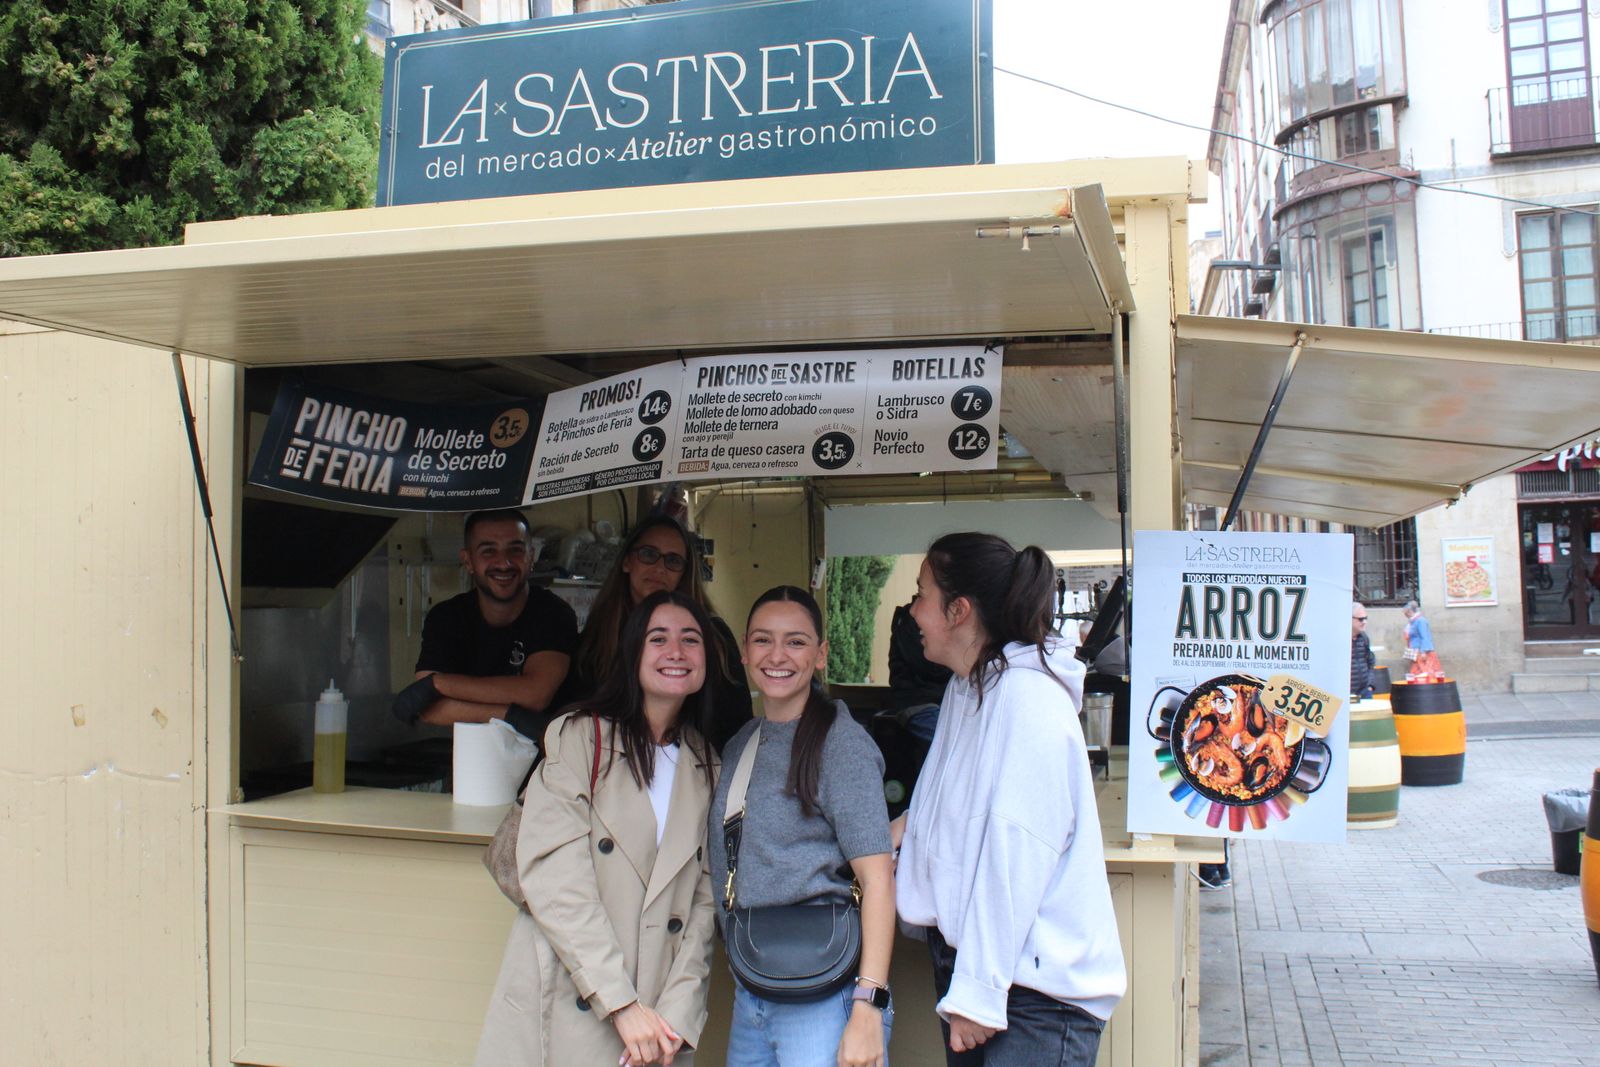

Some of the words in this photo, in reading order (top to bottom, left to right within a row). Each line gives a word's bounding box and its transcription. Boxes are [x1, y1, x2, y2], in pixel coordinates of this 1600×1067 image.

[418, 79, 490, 149] LA
[512, 32, 944, 138] SASTRERIA
[425, 156, 465, 181] del
[477, 142, 601, 175] mercado
[616, 134, 713, 163] Atelier
[718, 114, 937, 157] gastronómico
[697, 364, 769, 388] PINCHOS
[771, 369, 787, 380] DEL
[790, 361, 857, 384] SASTRE
[892, 357, 986, 382] BOTELLAS
[579, 377, 643, 412] PROMOS!
[688, 391, 726, 406] Mollete
[728, 391, 741, 403] de
[743, 390, 783, 402] secreto
[798, 393, 822, 401] kimchi
[877, 394, 945, 408] Lambrusco
[962, 392, 982, 412] 7€
[641, 396, 668, 417] 14€
[686, 406, 724, 420] Mollete
[726, 406, 739, 418] de
[741, 404, 768, 417] lomo
[770, 403, 817, 416] adobado
[833, 407, 855, 416] queso
[876, 411, 883, 420] o
[886, 407, 918, 420] Sidra
[294, 397, 407, 452] PINCHO
[545, 435, 551, 444] +
[553, 433, 560, 443] 4
[560, 426, 595, 442] Pinchos
[597, 424, 609, 435] de
[609, 417, 633, 432] Feria
[547, 417, 578, 434] Botella
[578, 418, 585, 426] de
[585, 415, 600, 425] sidra
[604, 407, 635, 419] Lambrusco
[684, 420, 722, 434] Mollete
[724, 420, 737, 432] de
[739, 419, 778, 432] ternera
[414, 428, 485, 451] Mollete
[639, 433, 659, 454] 8€
[682, 435, 695, 443] con
[695, 434, 706, 443] ajo
[706, 435, 711, 443] y
[712, 432, 734, 442] perejil
[874, 429, 909, 442] Novio
[955, 430, 987, 450] 12€
[283, 446, 307, 469] DE
[539, 452, 569, 469] Ración
[571, 450, 582, 462] de
[584, 442, 620, 460] Secreto
[681, 446, 708, 460] Tarta
[711, 444, 725, 457] de
[728, 444, 763, 460] queso
[765, 444, 805, 456] casera
[819, 439, 847, 462] 3,5€
[873, 441, 925, 455] Perfecto
[303, 443, 395, 495] FERIA
[407, 449, 433, 470] de
[435, 449, 506, 471] Secreto
[679, 461, 708, 472] BEBIDA:
[710, 460, 730, 471] Agua,
[732, 460, 760, 469] cerveza
[767, 459, 798, 468] refresco
[403, 473, 419, 482] con
[420, 473, 450, 483] kimchi
[537, 470, 546, 478] sin
[546, 467, 565, 476] bebida
[597, 478, 608, 487] POR
[638, 471, 655, 480] LOCAL
[428, 488, 446, 498] Agua,
[475, 488, 500, 496] refresco
[538, 490, 548, 498] SON
[1185, 546, 1202, 561] LA
[1207, 546, 1302, 562] SASTRERIA
[1466, 555, 1478, 569] 5
[1186, 574, 1211, 583] TODOS
[1212, 575, 1225, 583] LOS
[1227, 573, 1267, 584] MEDIODÍAS
[1268, 575, 1302, 585] NUESTRO
[1174, 584, 1310, 643] ARROZ
[1173, 643, 1233, 659] PREPARADO
[1236, 645, 1251, 659] AL
[1254, 645, 1309, 661] MOMENTO
[1286, 679, 1306, 691] ARROZ
[1310, 689, 1330, 703] BEBIDA
[1274, 685, 1324, 726] 3,50€
